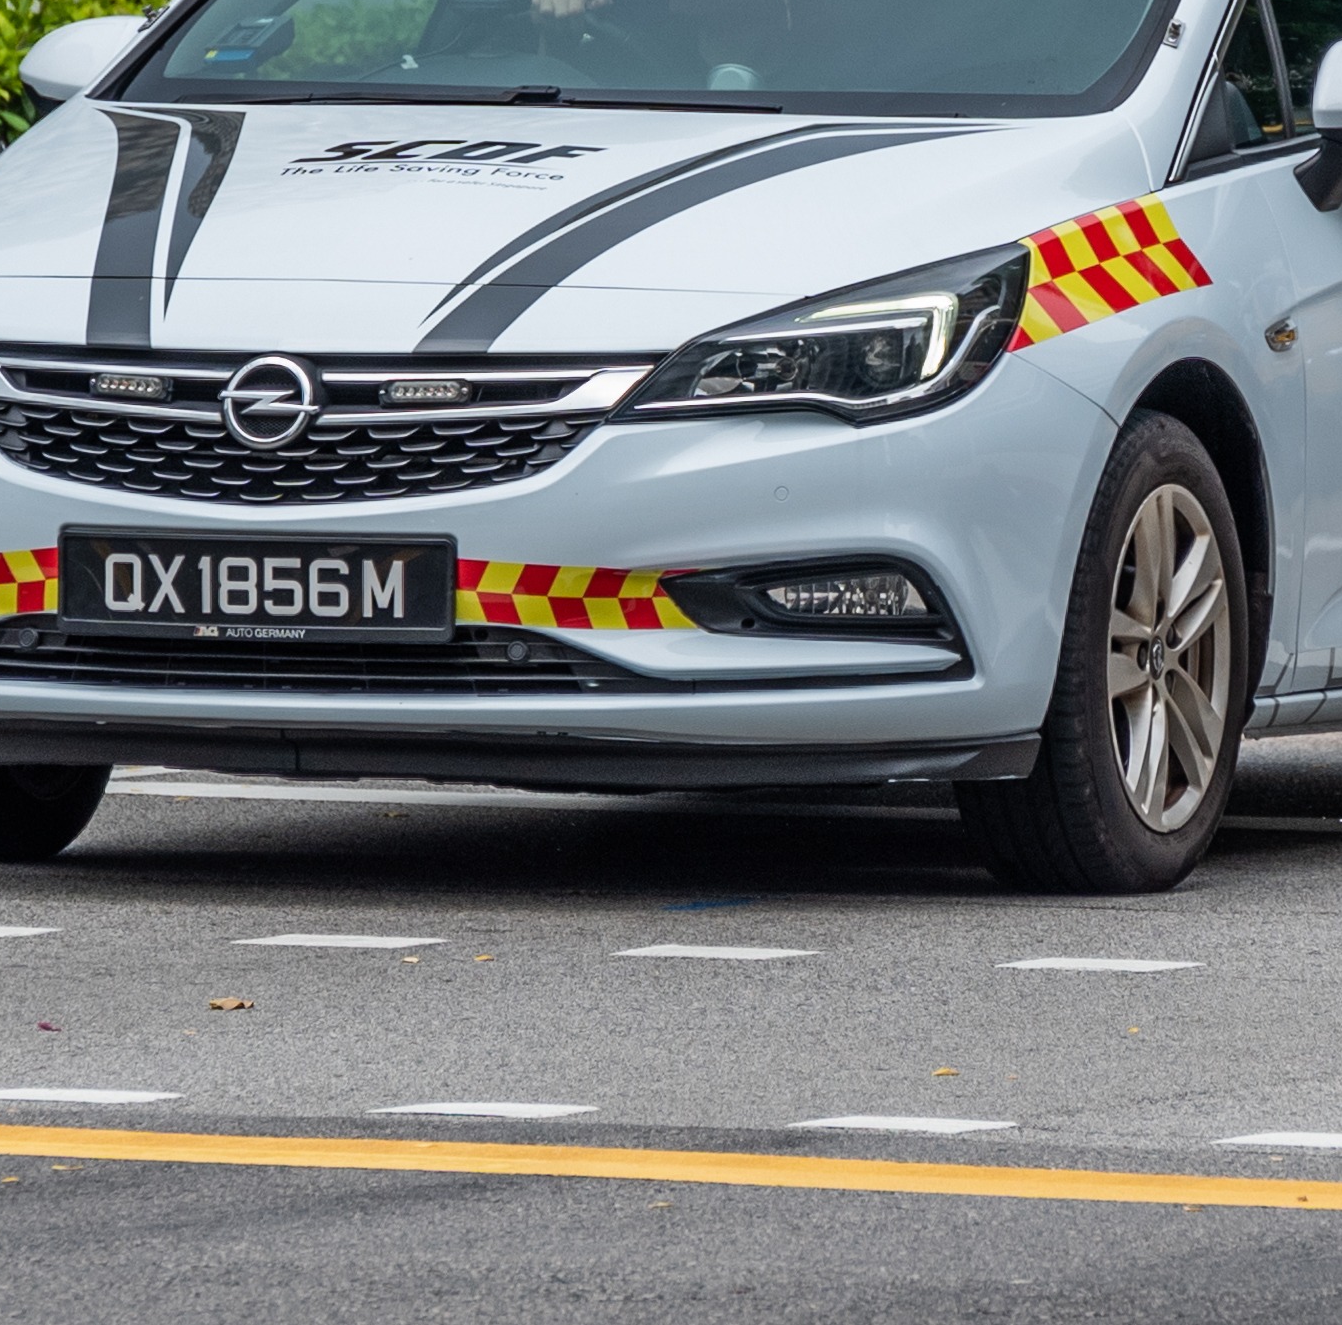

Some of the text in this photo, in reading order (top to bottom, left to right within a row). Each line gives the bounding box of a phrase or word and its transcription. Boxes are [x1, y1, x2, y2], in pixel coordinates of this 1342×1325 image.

[289, 140, 609, 164] SCDF
[280, 163, 565, 182] The Life Saving Force
[104, 553, 405, 619] QX1856M
[225, 627, 253, 638] AUTO
[255, 628, 306, 639] GERMANY
